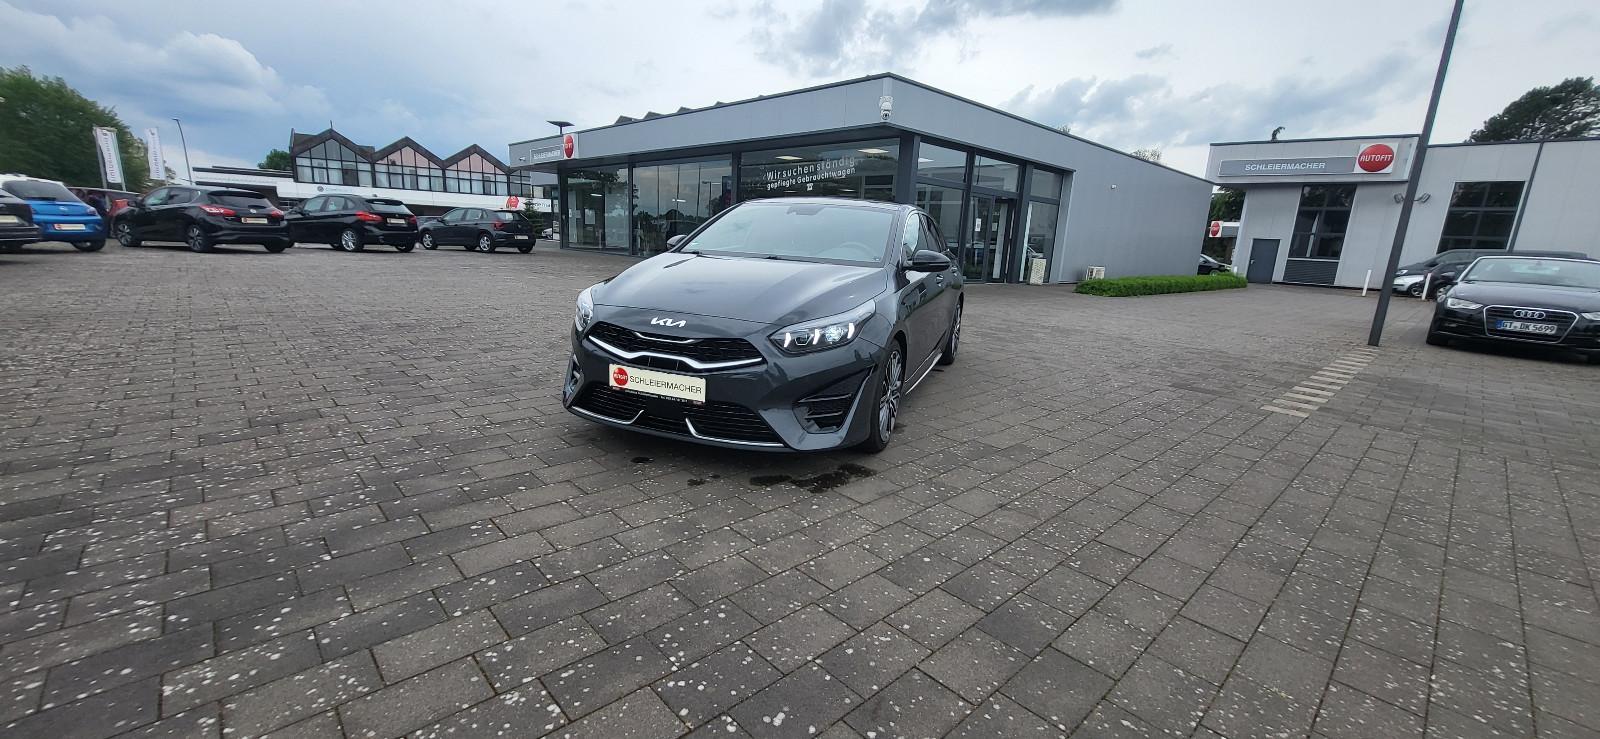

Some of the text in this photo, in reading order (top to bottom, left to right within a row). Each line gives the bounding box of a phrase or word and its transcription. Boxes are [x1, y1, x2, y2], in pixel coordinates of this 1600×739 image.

[1359, 154, 1393, 162] AUTOFIT
[766, 169, 781, 180] Wir
[782, 165, 815, 178] suchen
[1244, 162, 1326, 171] SCHLEIERMACHER
[766, 168, 856, 191] gepflegte Gebrauchtwagen
[1532, 325, 1556, 333] 5699
[629, 375, 702, 394] SCHLEIERMACHER
